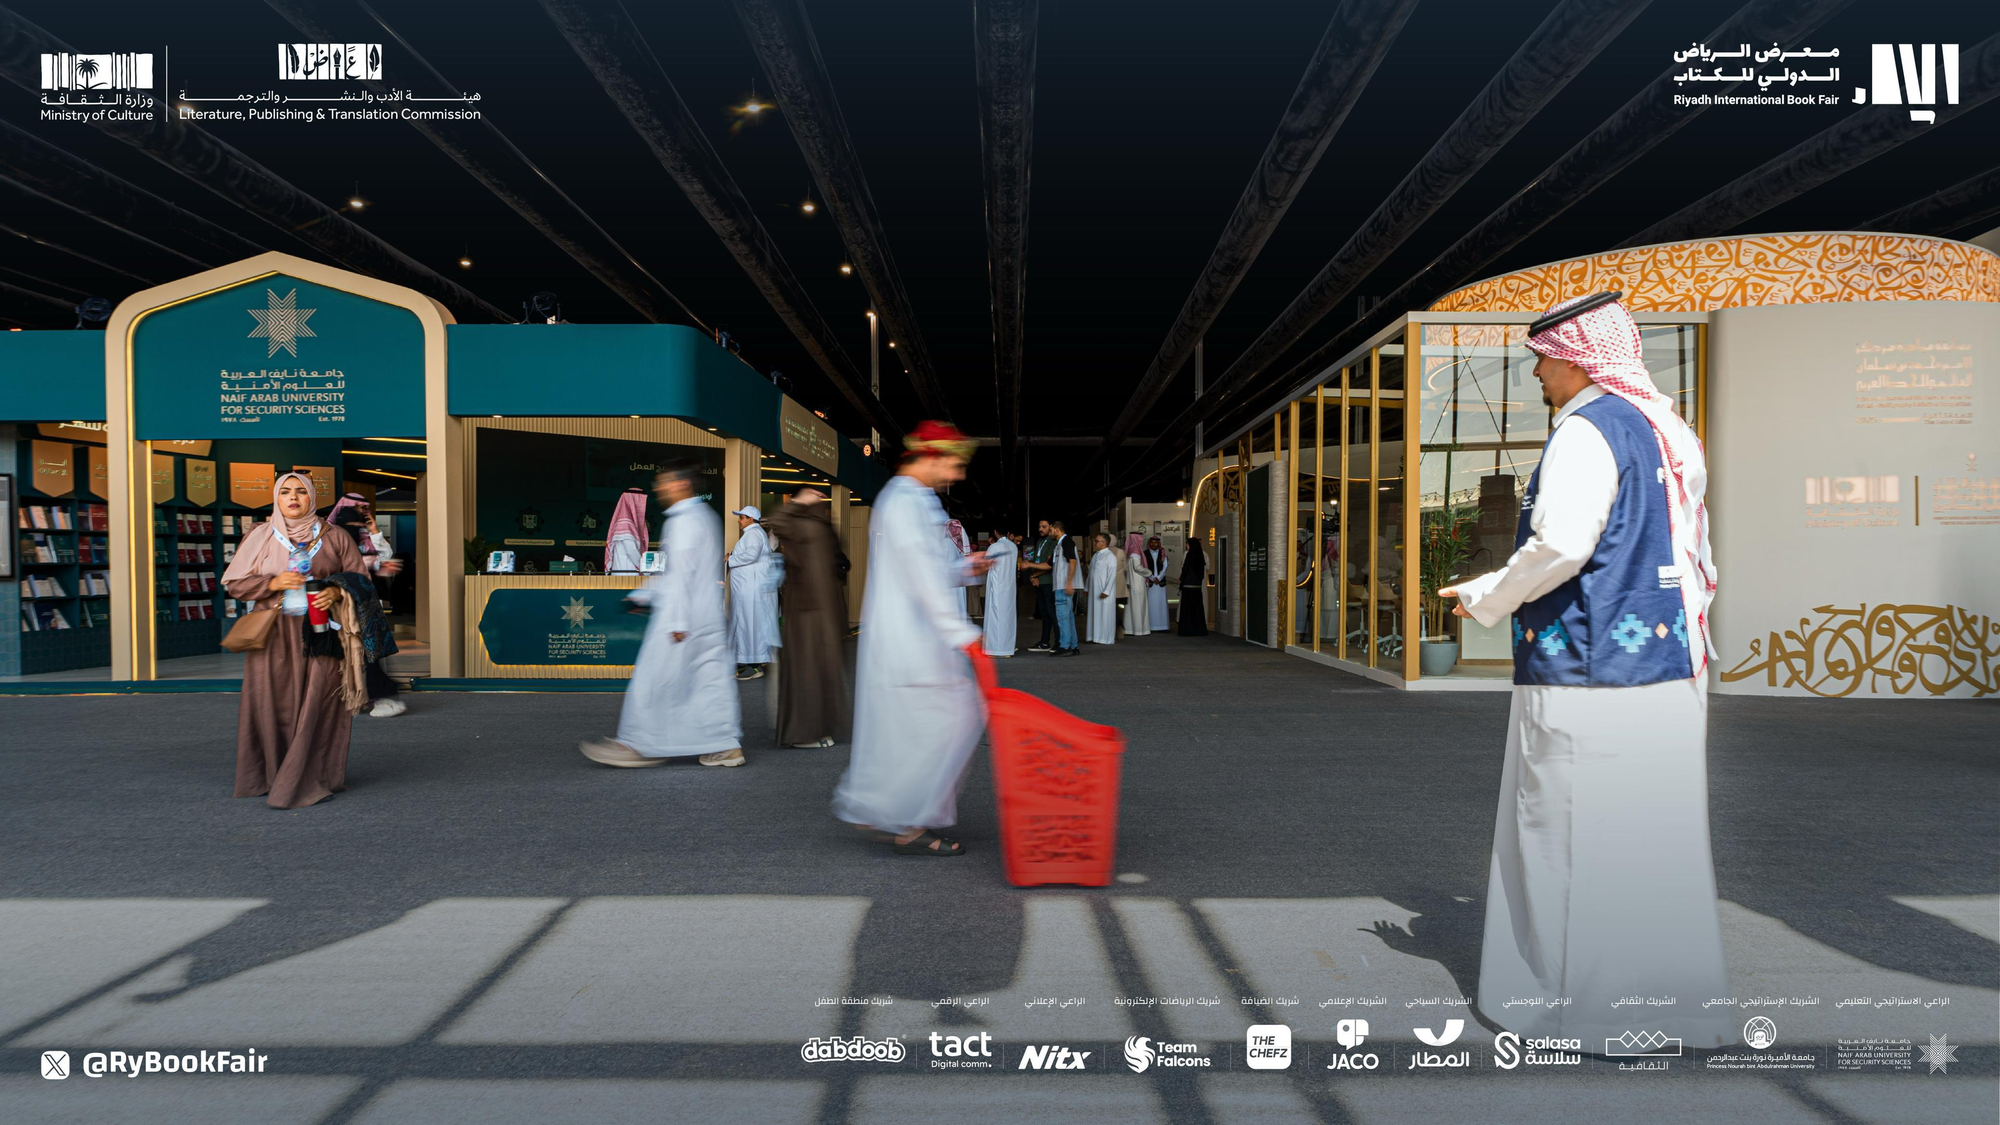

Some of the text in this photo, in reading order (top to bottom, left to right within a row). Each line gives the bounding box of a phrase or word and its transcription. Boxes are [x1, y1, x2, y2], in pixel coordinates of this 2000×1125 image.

[220, 369, 345, 381] جامعة نايف العربية
[220, 379, 345, 393] للعلوم الأمنية
[220, 392, 345, 403] NAIF ARAB UNIVERSITY
[220, 404, 345, 415] FOR SECURITY SCIENCES
